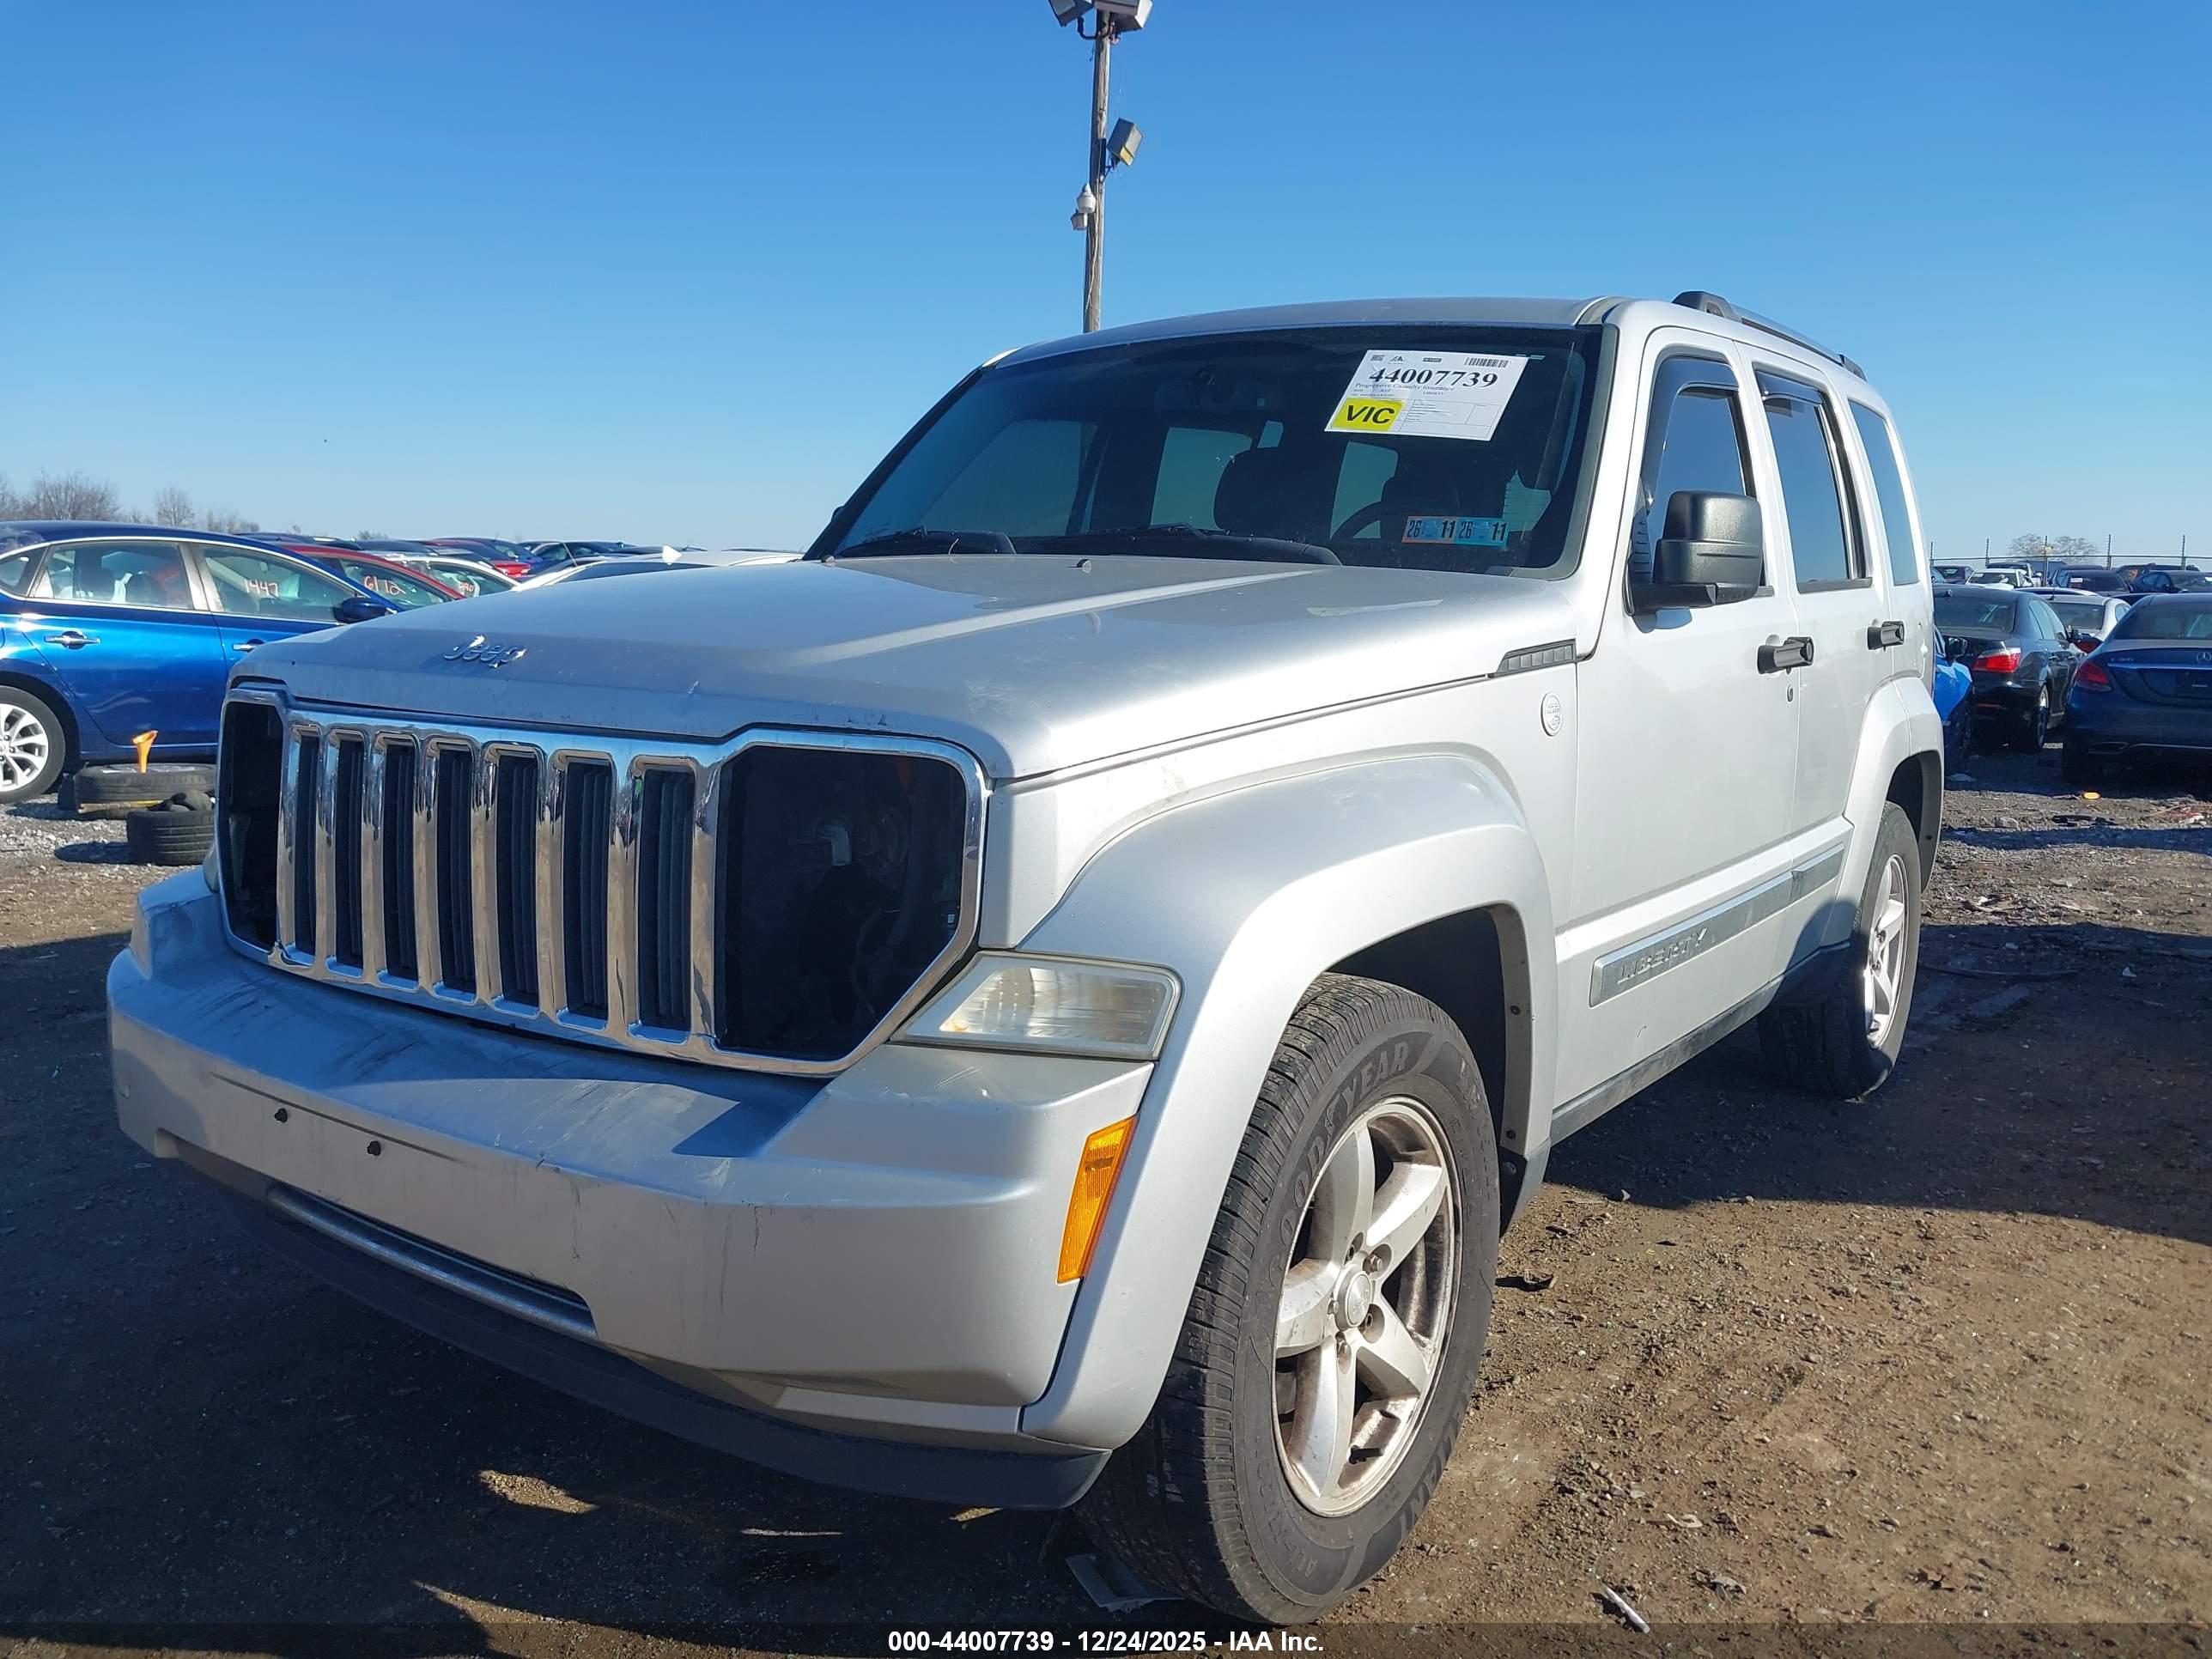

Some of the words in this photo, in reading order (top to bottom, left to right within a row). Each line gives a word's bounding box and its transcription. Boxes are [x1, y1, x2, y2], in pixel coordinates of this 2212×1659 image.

[1369, 368, 1498, 387] 44007739
[1346, 404, 1395, 424] VIC
[1407, 520, 1423, 538] 26
[443, 635, 527, 669] Jeep
[1617, 927, 1708, 984] LIBERTY
